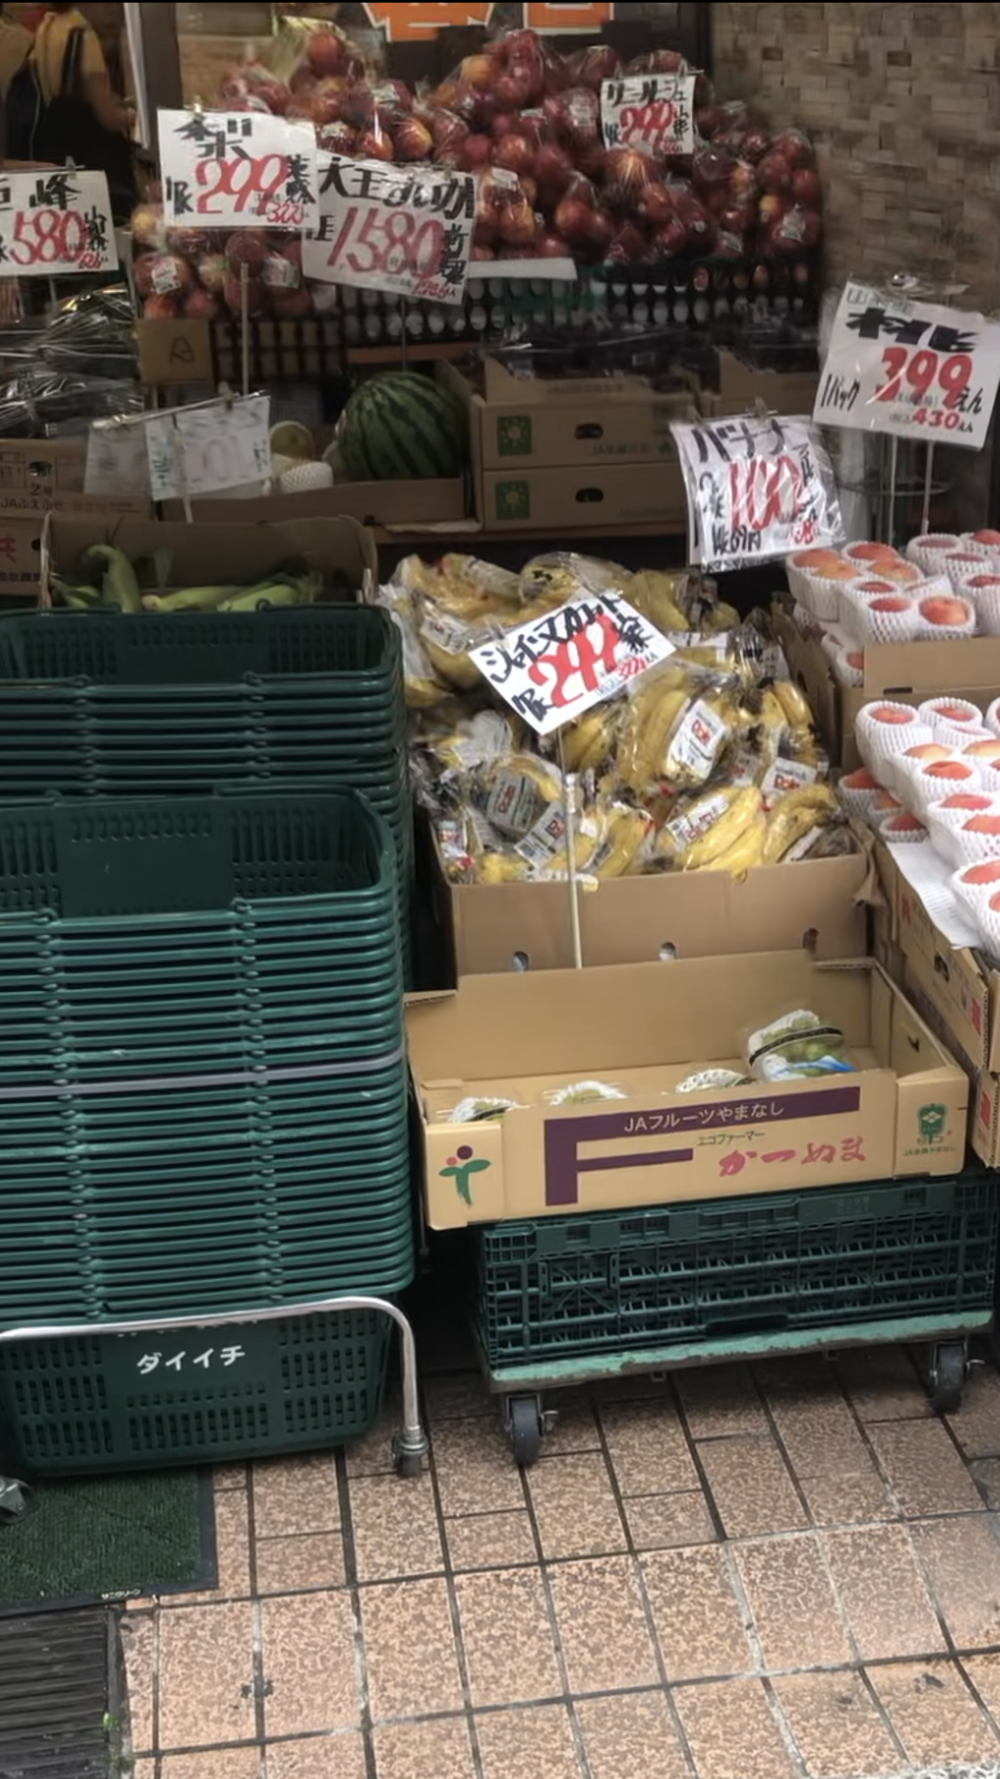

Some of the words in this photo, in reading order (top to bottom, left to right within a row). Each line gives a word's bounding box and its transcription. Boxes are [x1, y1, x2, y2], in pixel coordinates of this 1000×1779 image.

[195, 154, 292, 216] 299
[9, 209, 87, 266] 580
[874, 347, 973, 412] 399
[691, 418, 793, 464] バナナ
[911, 407, 961, 431] 430
[729, 455, 803, 534] 100
[527, 613, 622, 709] 299
[623, 1102, 785, 1133] JAフルーツやまなし
[696, 1130, 766, 1148] エコファーマー
[718, 1135, 867, 1178] かつぬま
[137, 1345, 246, 1375] ダイイチ
